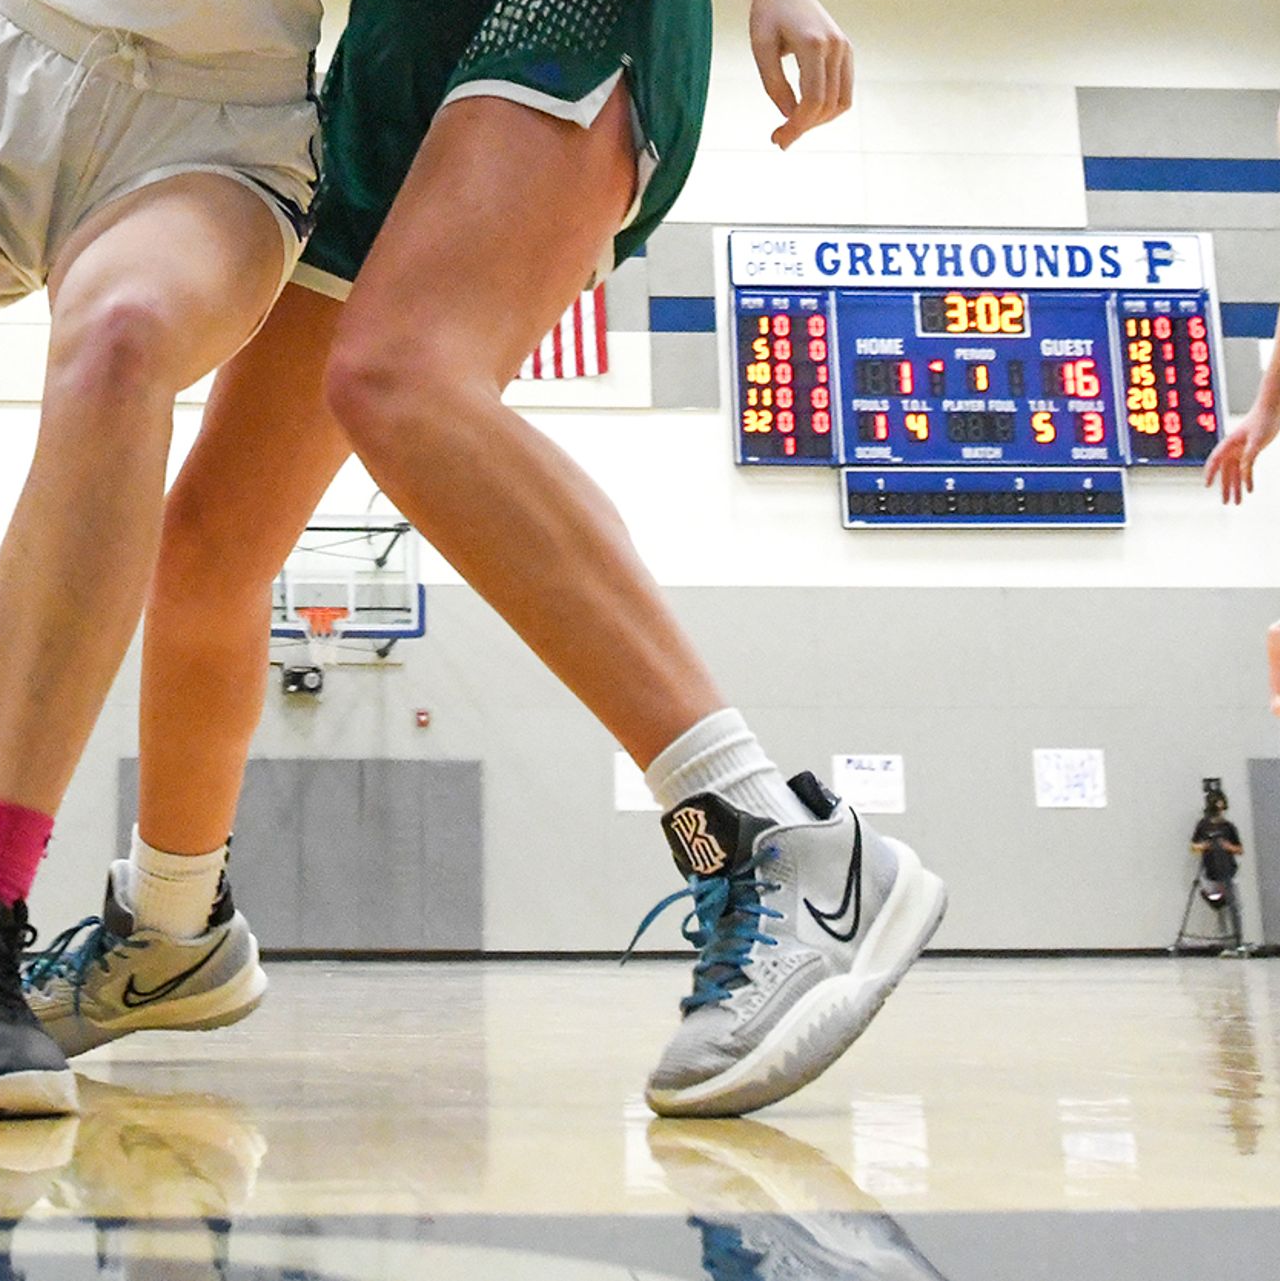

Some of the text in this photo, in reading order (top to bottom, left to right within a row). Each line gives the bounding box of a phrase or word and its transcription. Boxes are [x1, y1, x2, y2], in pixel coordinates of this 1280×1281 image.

[752, 241, 797, 255] HOME
[815, 241, 1123, 278] GREYHOUNDS
[747, 262, 766, 276] OF
[944, 292, 1024, 333] 3:02
[758, 314, 826, 337] 1 0 0
[1126, 317, 1207, 340] 11 0 6
[752, 337, 827, 361] 5 0 0
[855, 338, 905, 355] HOME
[1040, 339, 1094, 356] GUEST
[1128, 340, 1153, 362] 12
[1190, 341, 1208, 363] 0
[746, 362, 771, 385] 10
[774, 362, 793, 385] 0
[898, 360, 913, 395] 1
[975, 364, 989, 391] 1
[1062, 358, 1100, 397] 16
[1130, 364, 1156, 386] 15
[1193, 364, 1211, 386] 2
[747, 386, 829, 409] 11 0 0
[942, 400, 985, 412] PLAYER
[1126, 387, 1158, 410] 20
[1194, 389, 1213, 408] 4
[743, 409, 830, 433] 32 0 0
[873, 412, 1105, 444] 1 4 5 3
[1128, 411, 1216, 435] 40 0 4
[1167, 435, 1184, 458] 3
[875, 477, 885, 490] 1
